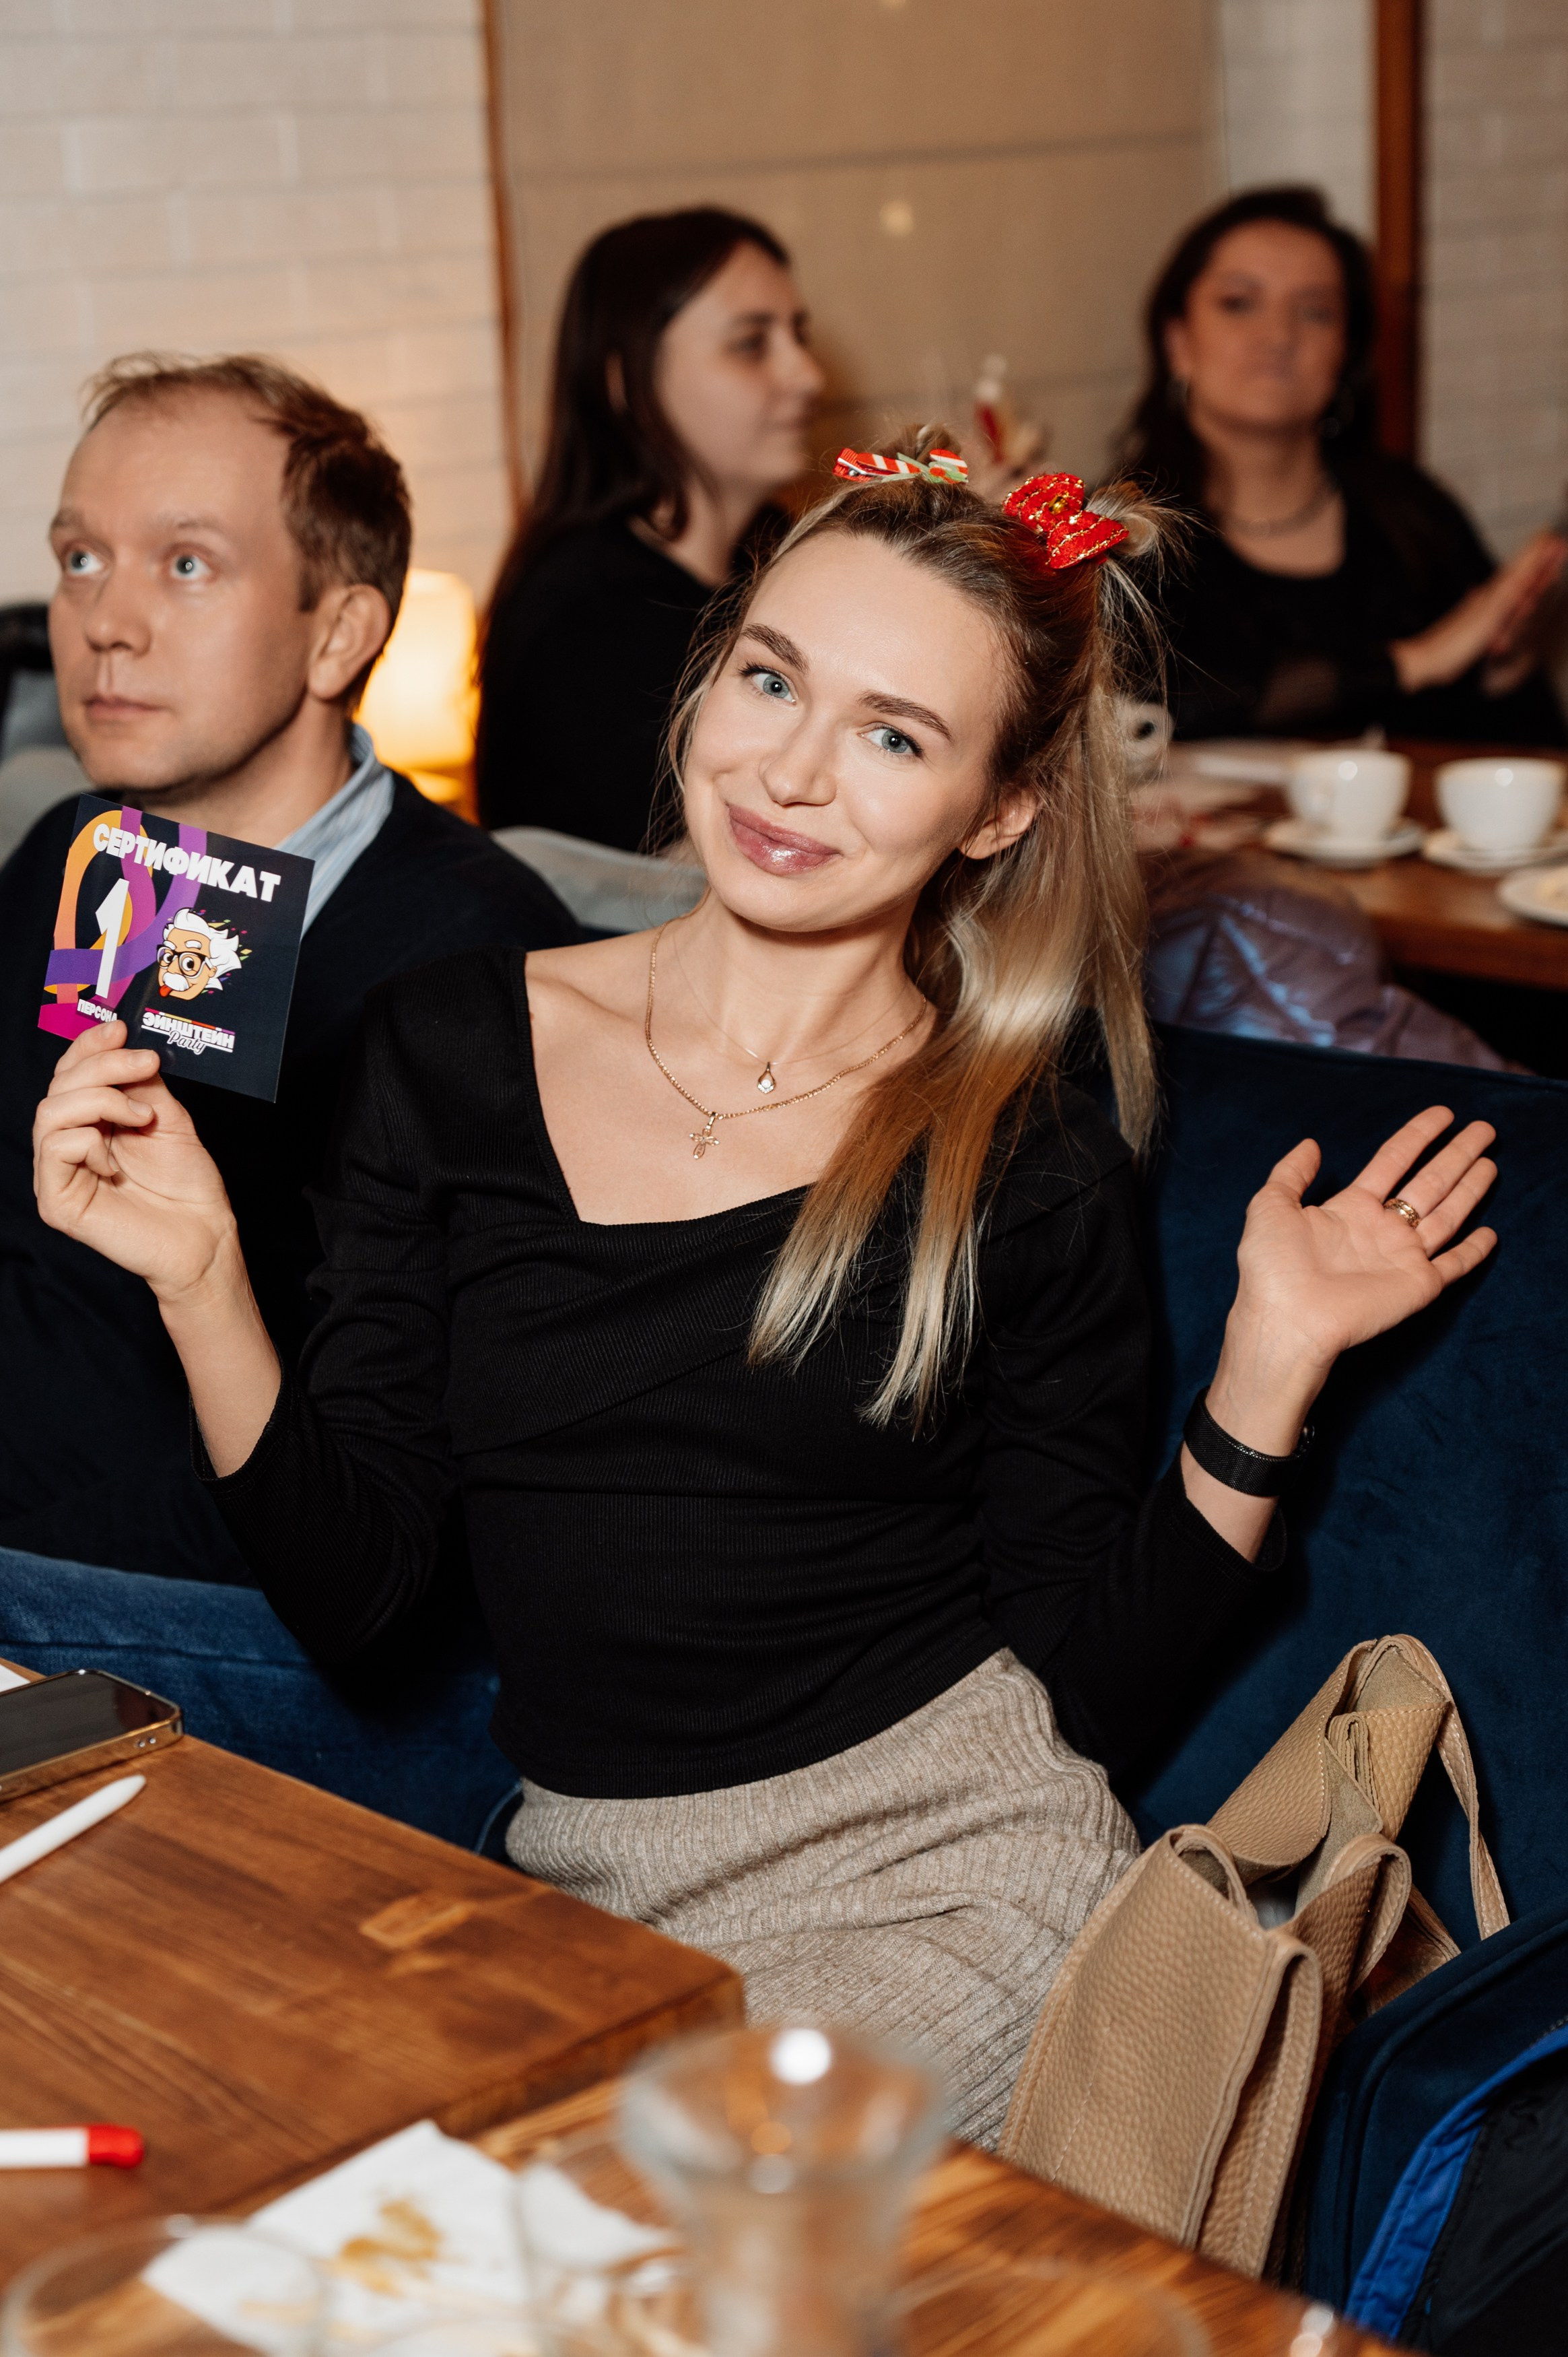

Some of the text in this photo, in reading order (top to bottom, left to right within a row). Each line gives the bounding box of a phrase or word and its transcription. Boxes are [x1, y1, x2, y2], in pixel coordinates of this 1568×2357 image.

[93, 823, 281, 902] СЕРТИФИКАТ
[95, 877, 130, 999] 1
[77, 999, 118, 1023] ПЕРСОНА
[143, 1011, 235, 1049] ЭЙНШТЕЙН
[168, 1030, 205, 1055] Party
